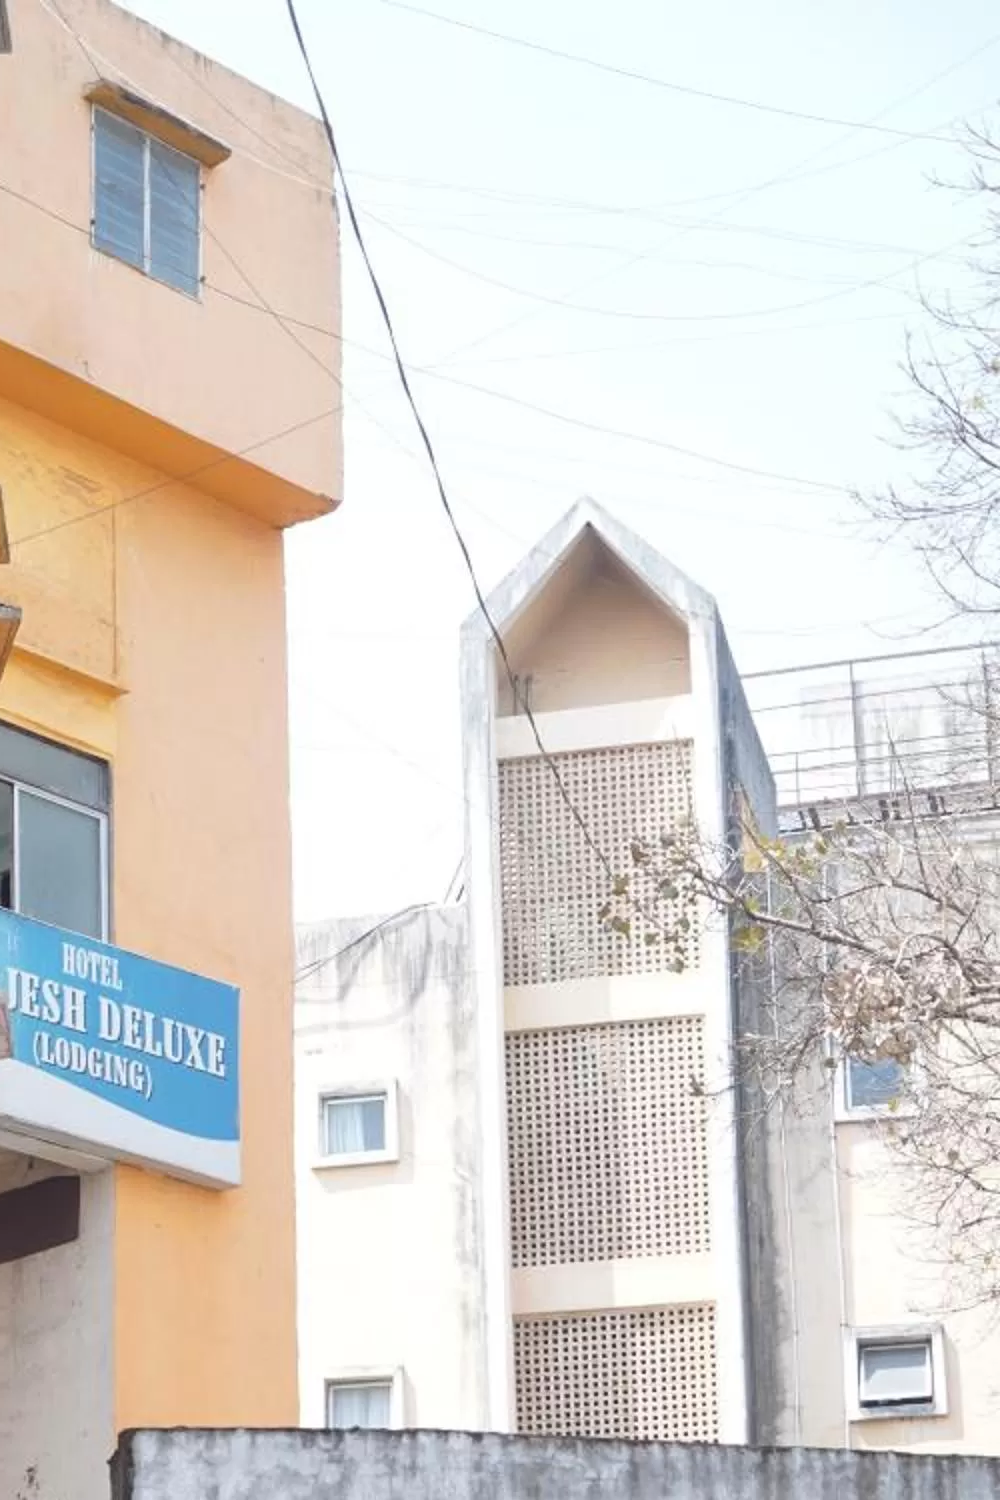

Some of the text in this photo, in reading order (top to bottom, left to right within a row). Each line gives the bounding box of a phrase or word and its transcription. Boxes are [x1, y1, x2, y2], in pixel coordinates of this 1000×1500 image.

[62, 943, 123, 991] HOTEL
[33, 1031, 152, 1101] (LODGING)
[99, 995, 226, 1078] DELUXE
